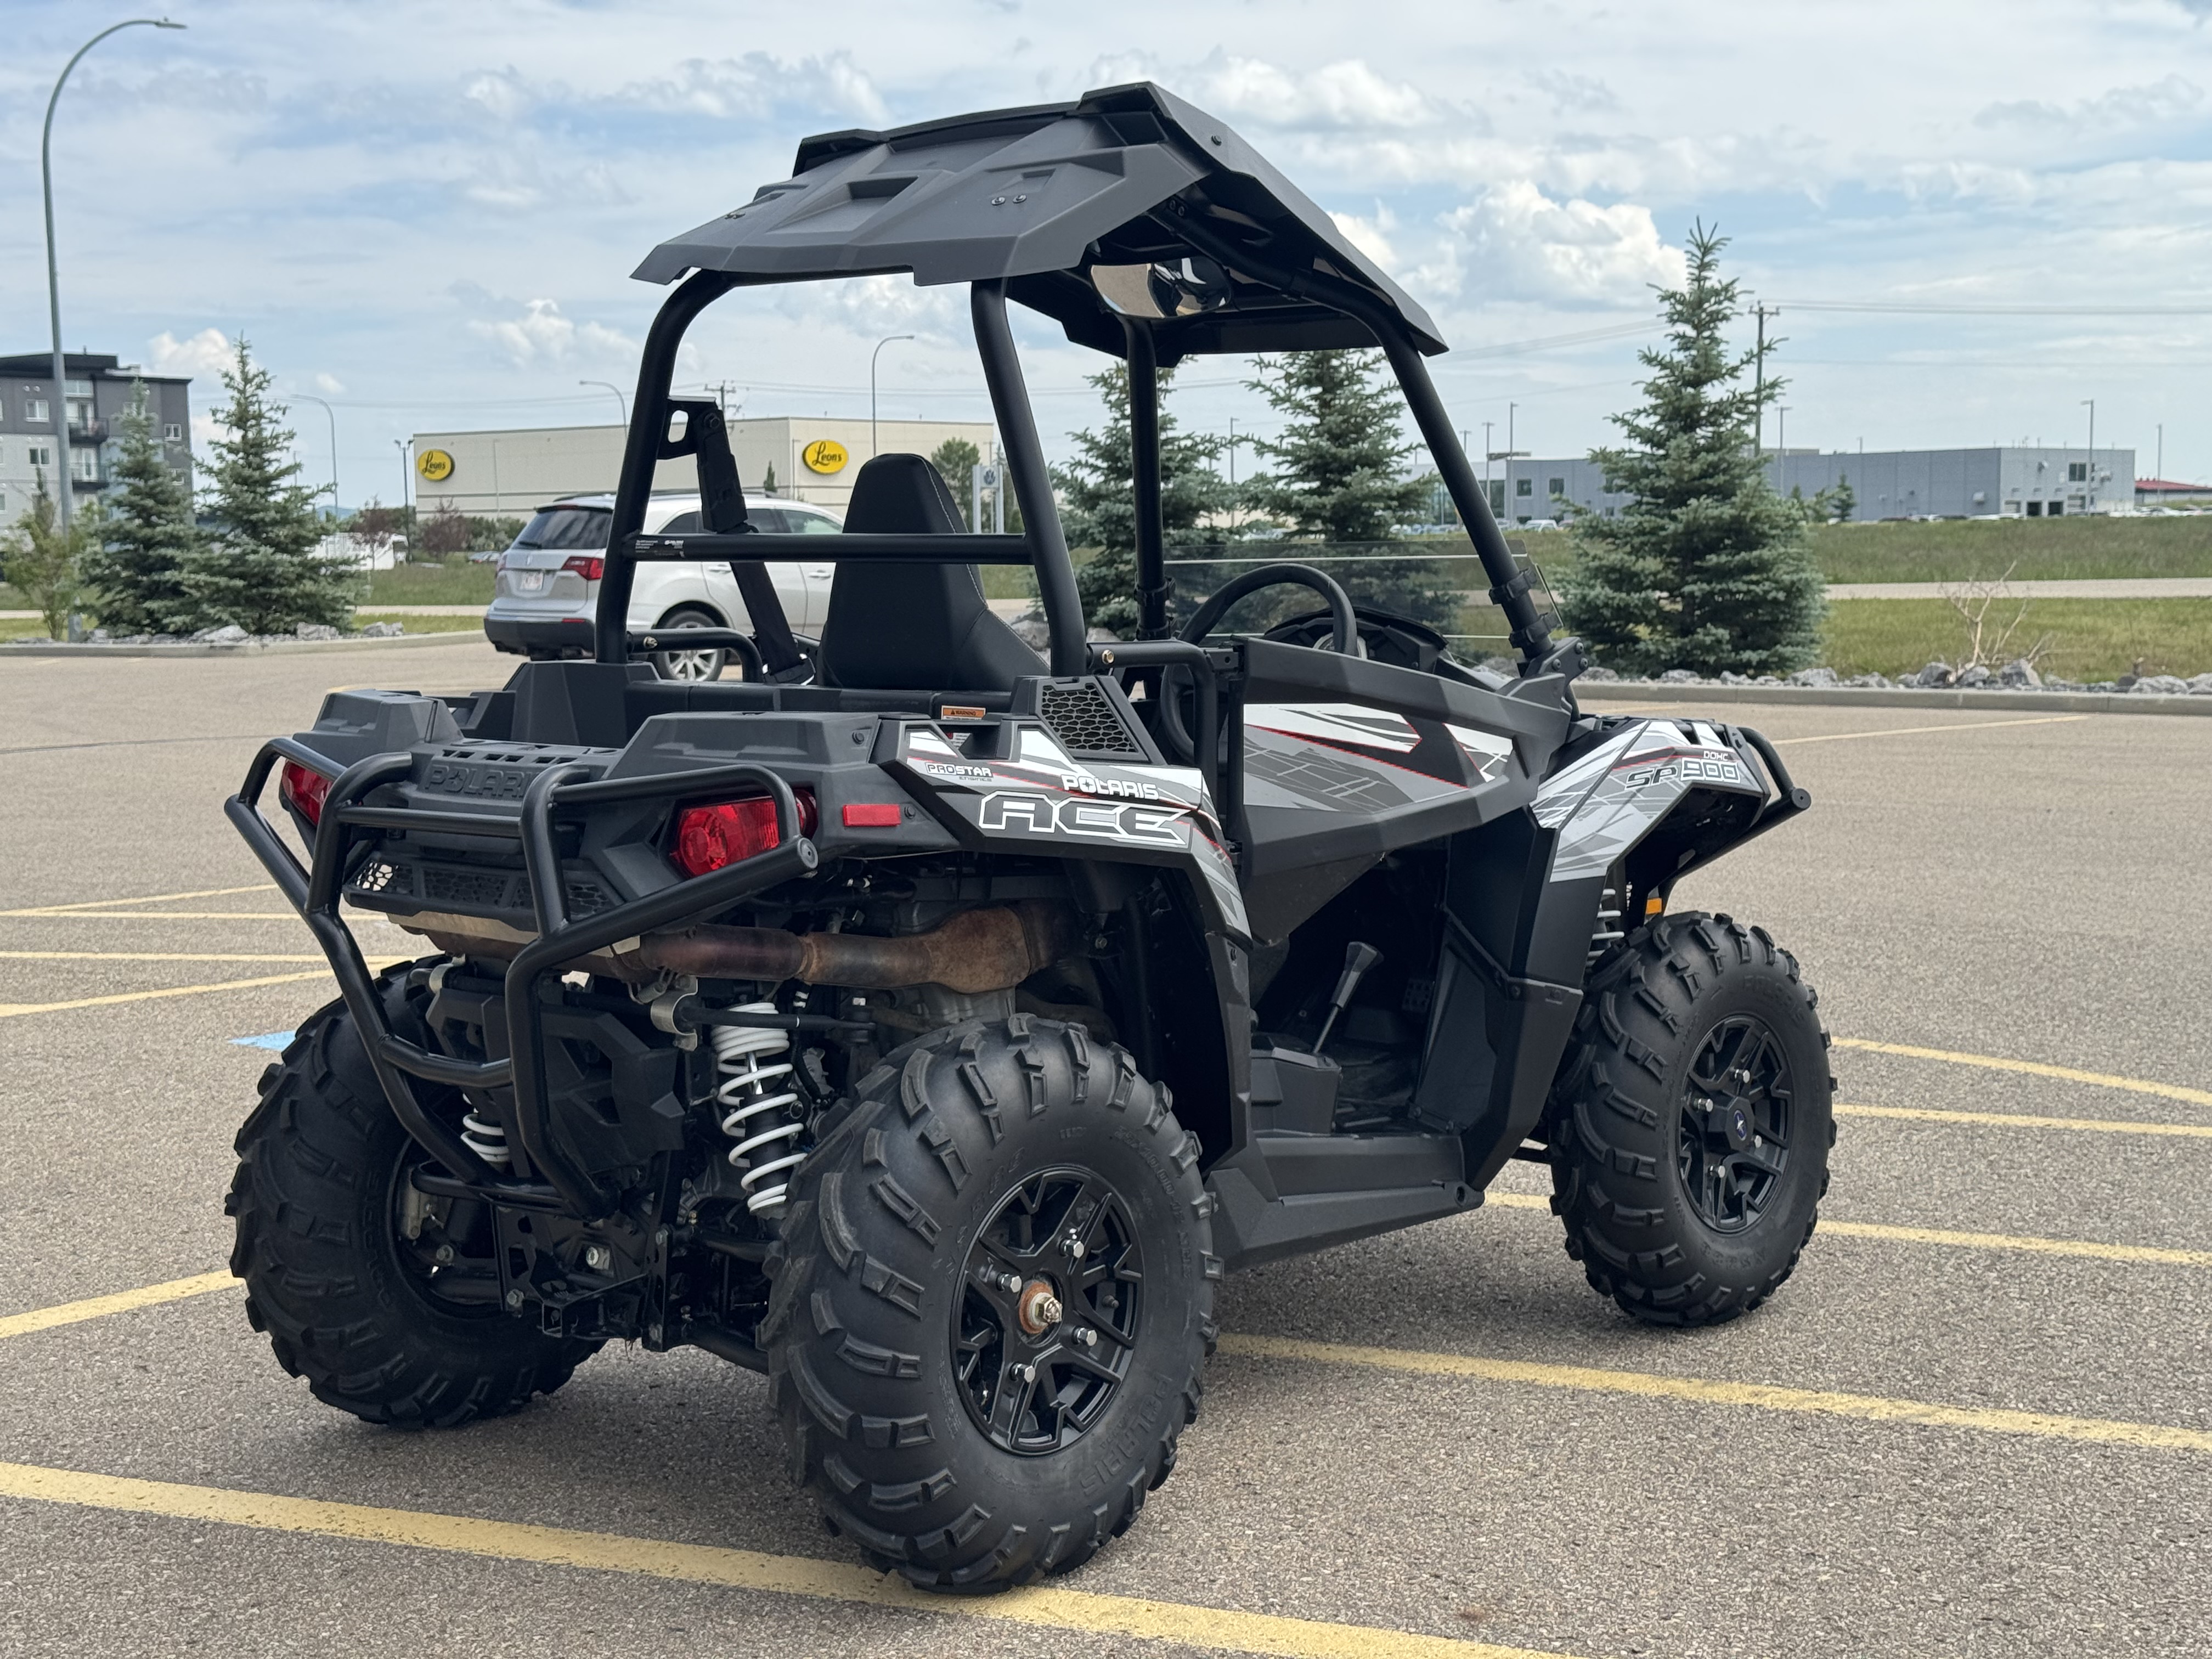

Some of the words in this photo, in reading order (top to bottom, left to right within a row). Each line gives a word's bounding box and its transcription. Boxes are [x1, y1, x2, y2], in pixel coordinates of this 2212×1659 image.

[926, 763, 994, 777] PROSTAR
[1703, 750, 1729, 761] DOHC
[424, 764, 537, 799] POLARI
[1063, 774, 1159, 800] POLARIS
[979, 790, 1188, 845] ACE
[1080, 1372, 1174, 1496] POLARIS
